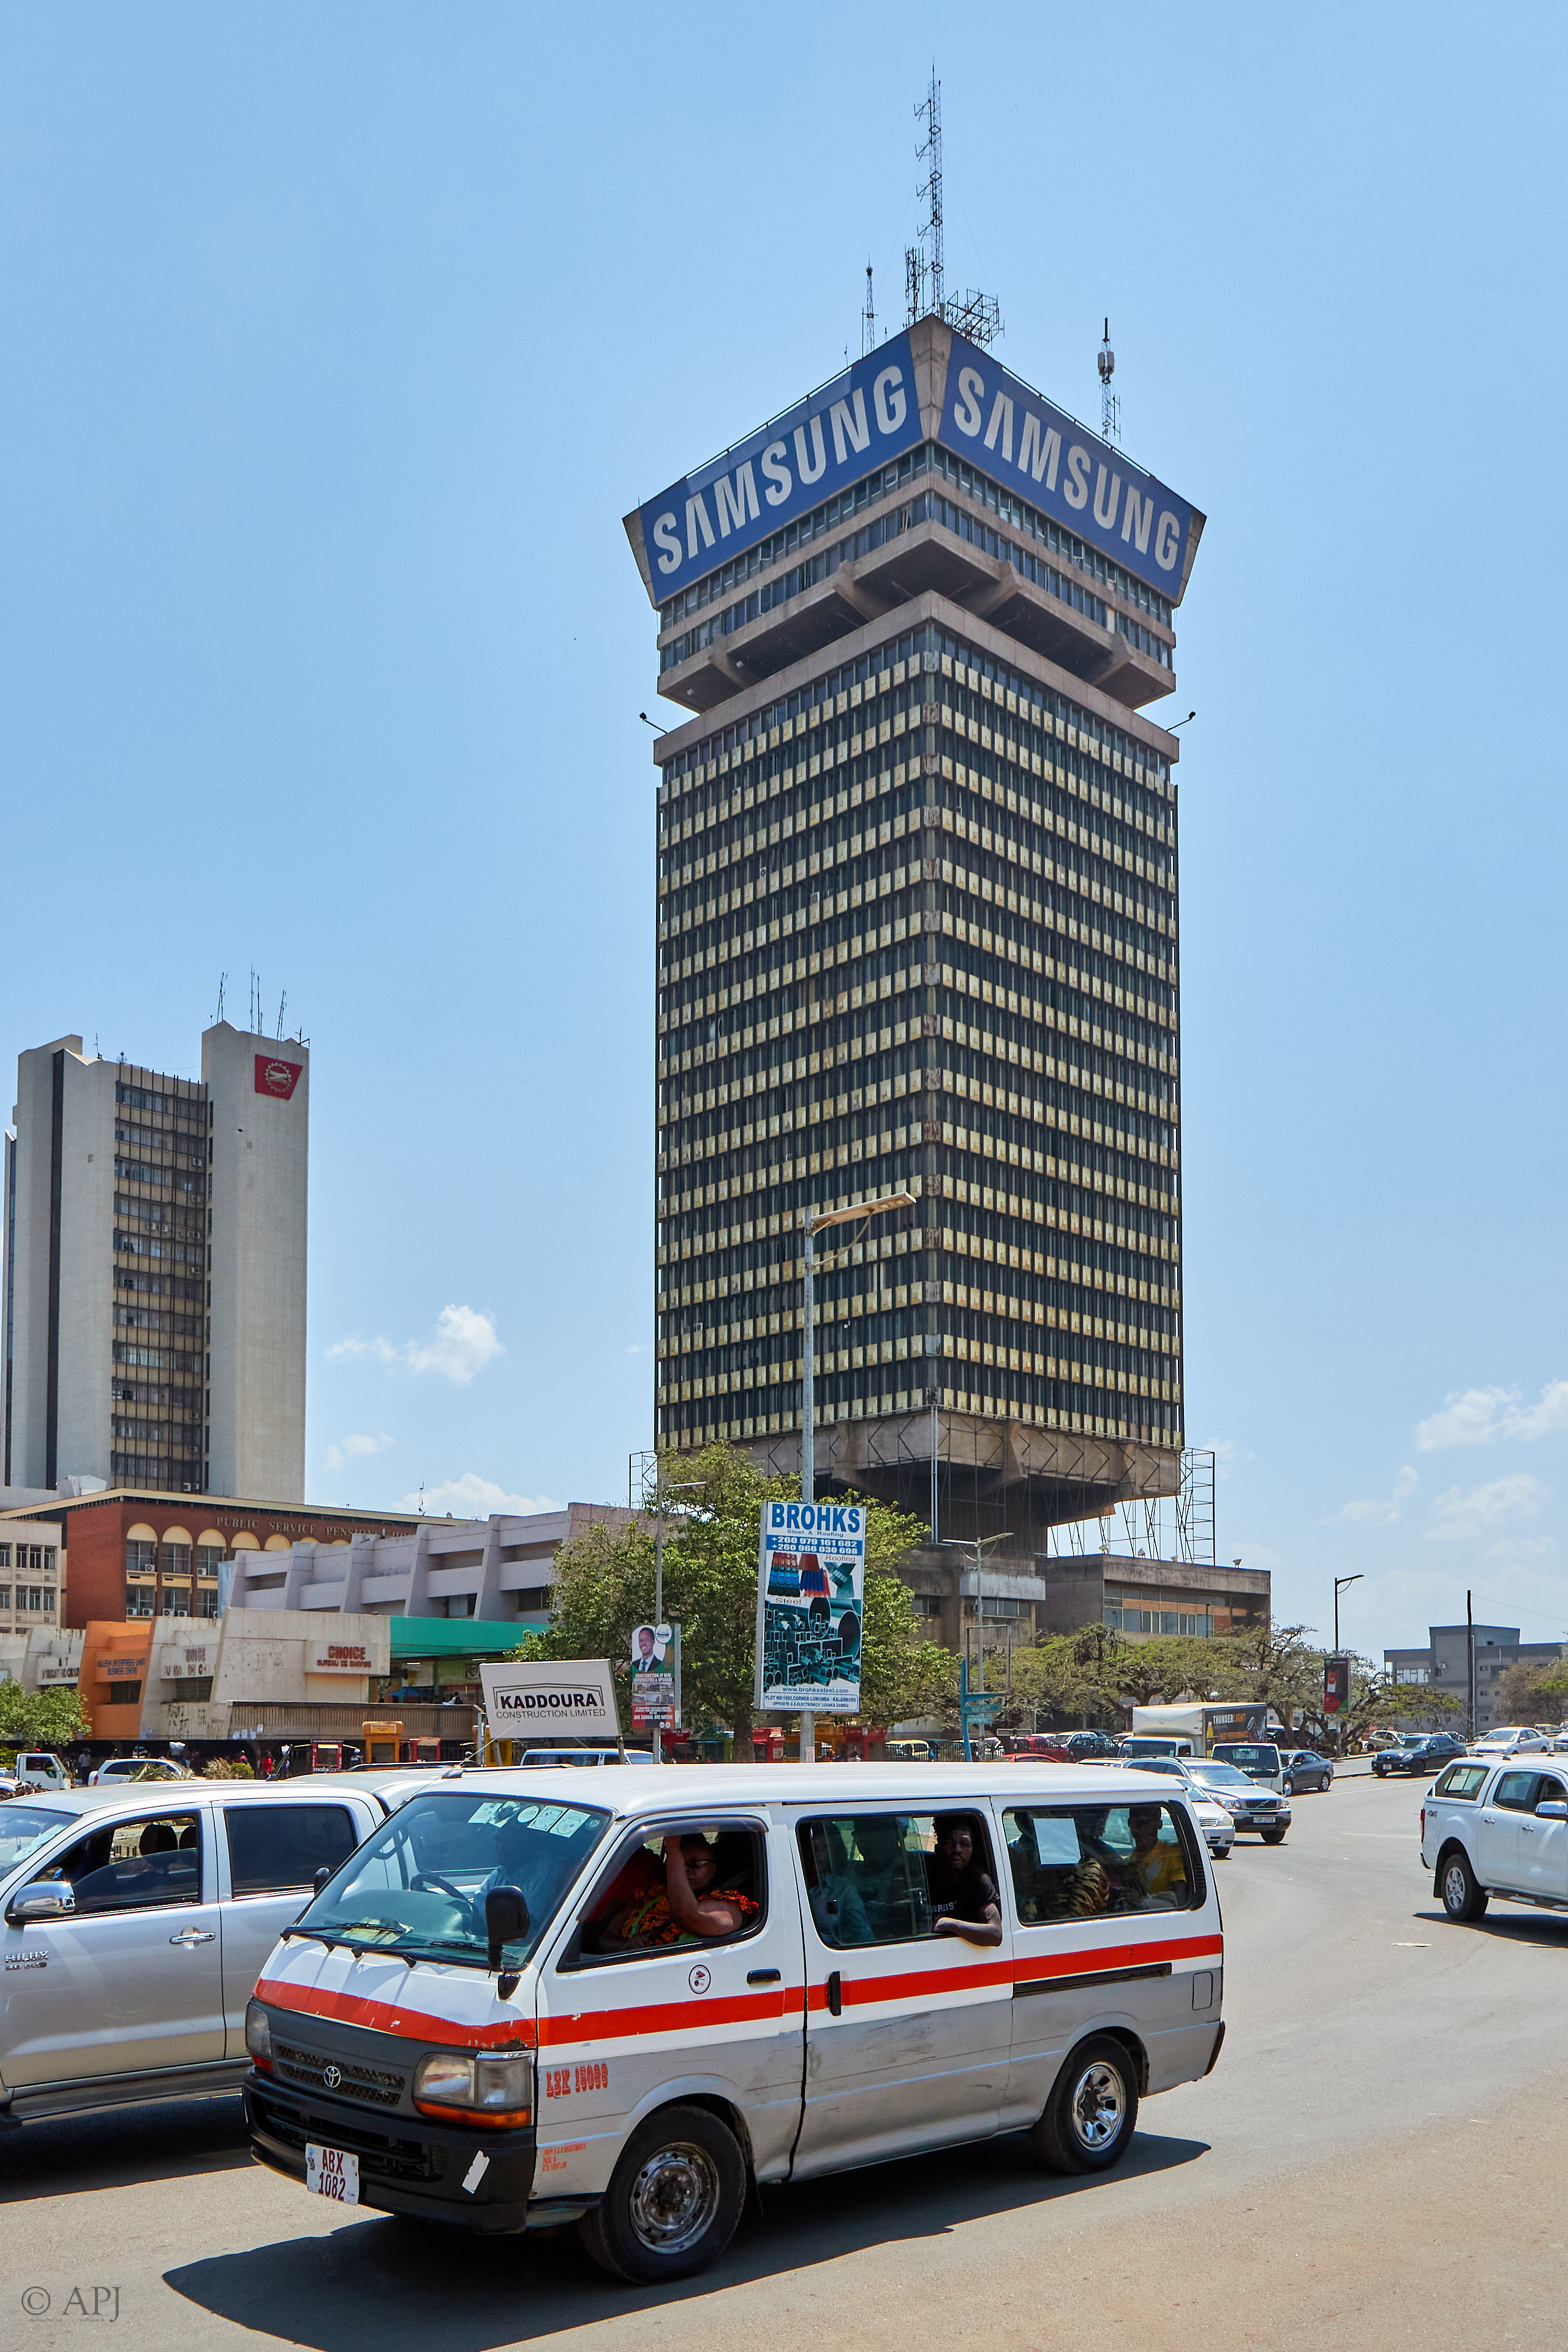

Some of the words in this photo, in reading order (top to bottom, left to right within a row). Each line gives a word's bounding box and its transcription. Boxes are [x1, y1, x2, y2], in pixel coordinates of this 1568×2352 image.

[652, 366, 907, 575] SAMSUNG
[954, 366, 1181, 572] SAMSUNG
[216, 1517, 259, 1529] PUBLIC
[268, 1521, 317, 1534] SERVICE
[772, 1503, 860, 1533] BROHKS
[825, 1555, 856, 1563] Roofing
[328, 1645, 366, 1660] CHOICE
[500, 1693, 598, 1709] KADDOURA
[496, 1709, 568, 1719] CONSTRUCTION
[570, 1708, 606, 1717] LIMITED
[5, 1950, 49, 1962] HILUX
[546, 2068, 571, 2098] LSK
[575, 2061, 608, 2093] 15088
[323, 2149, 344, 2176] ABX
[318, 2171, 345, 2201] 1082
